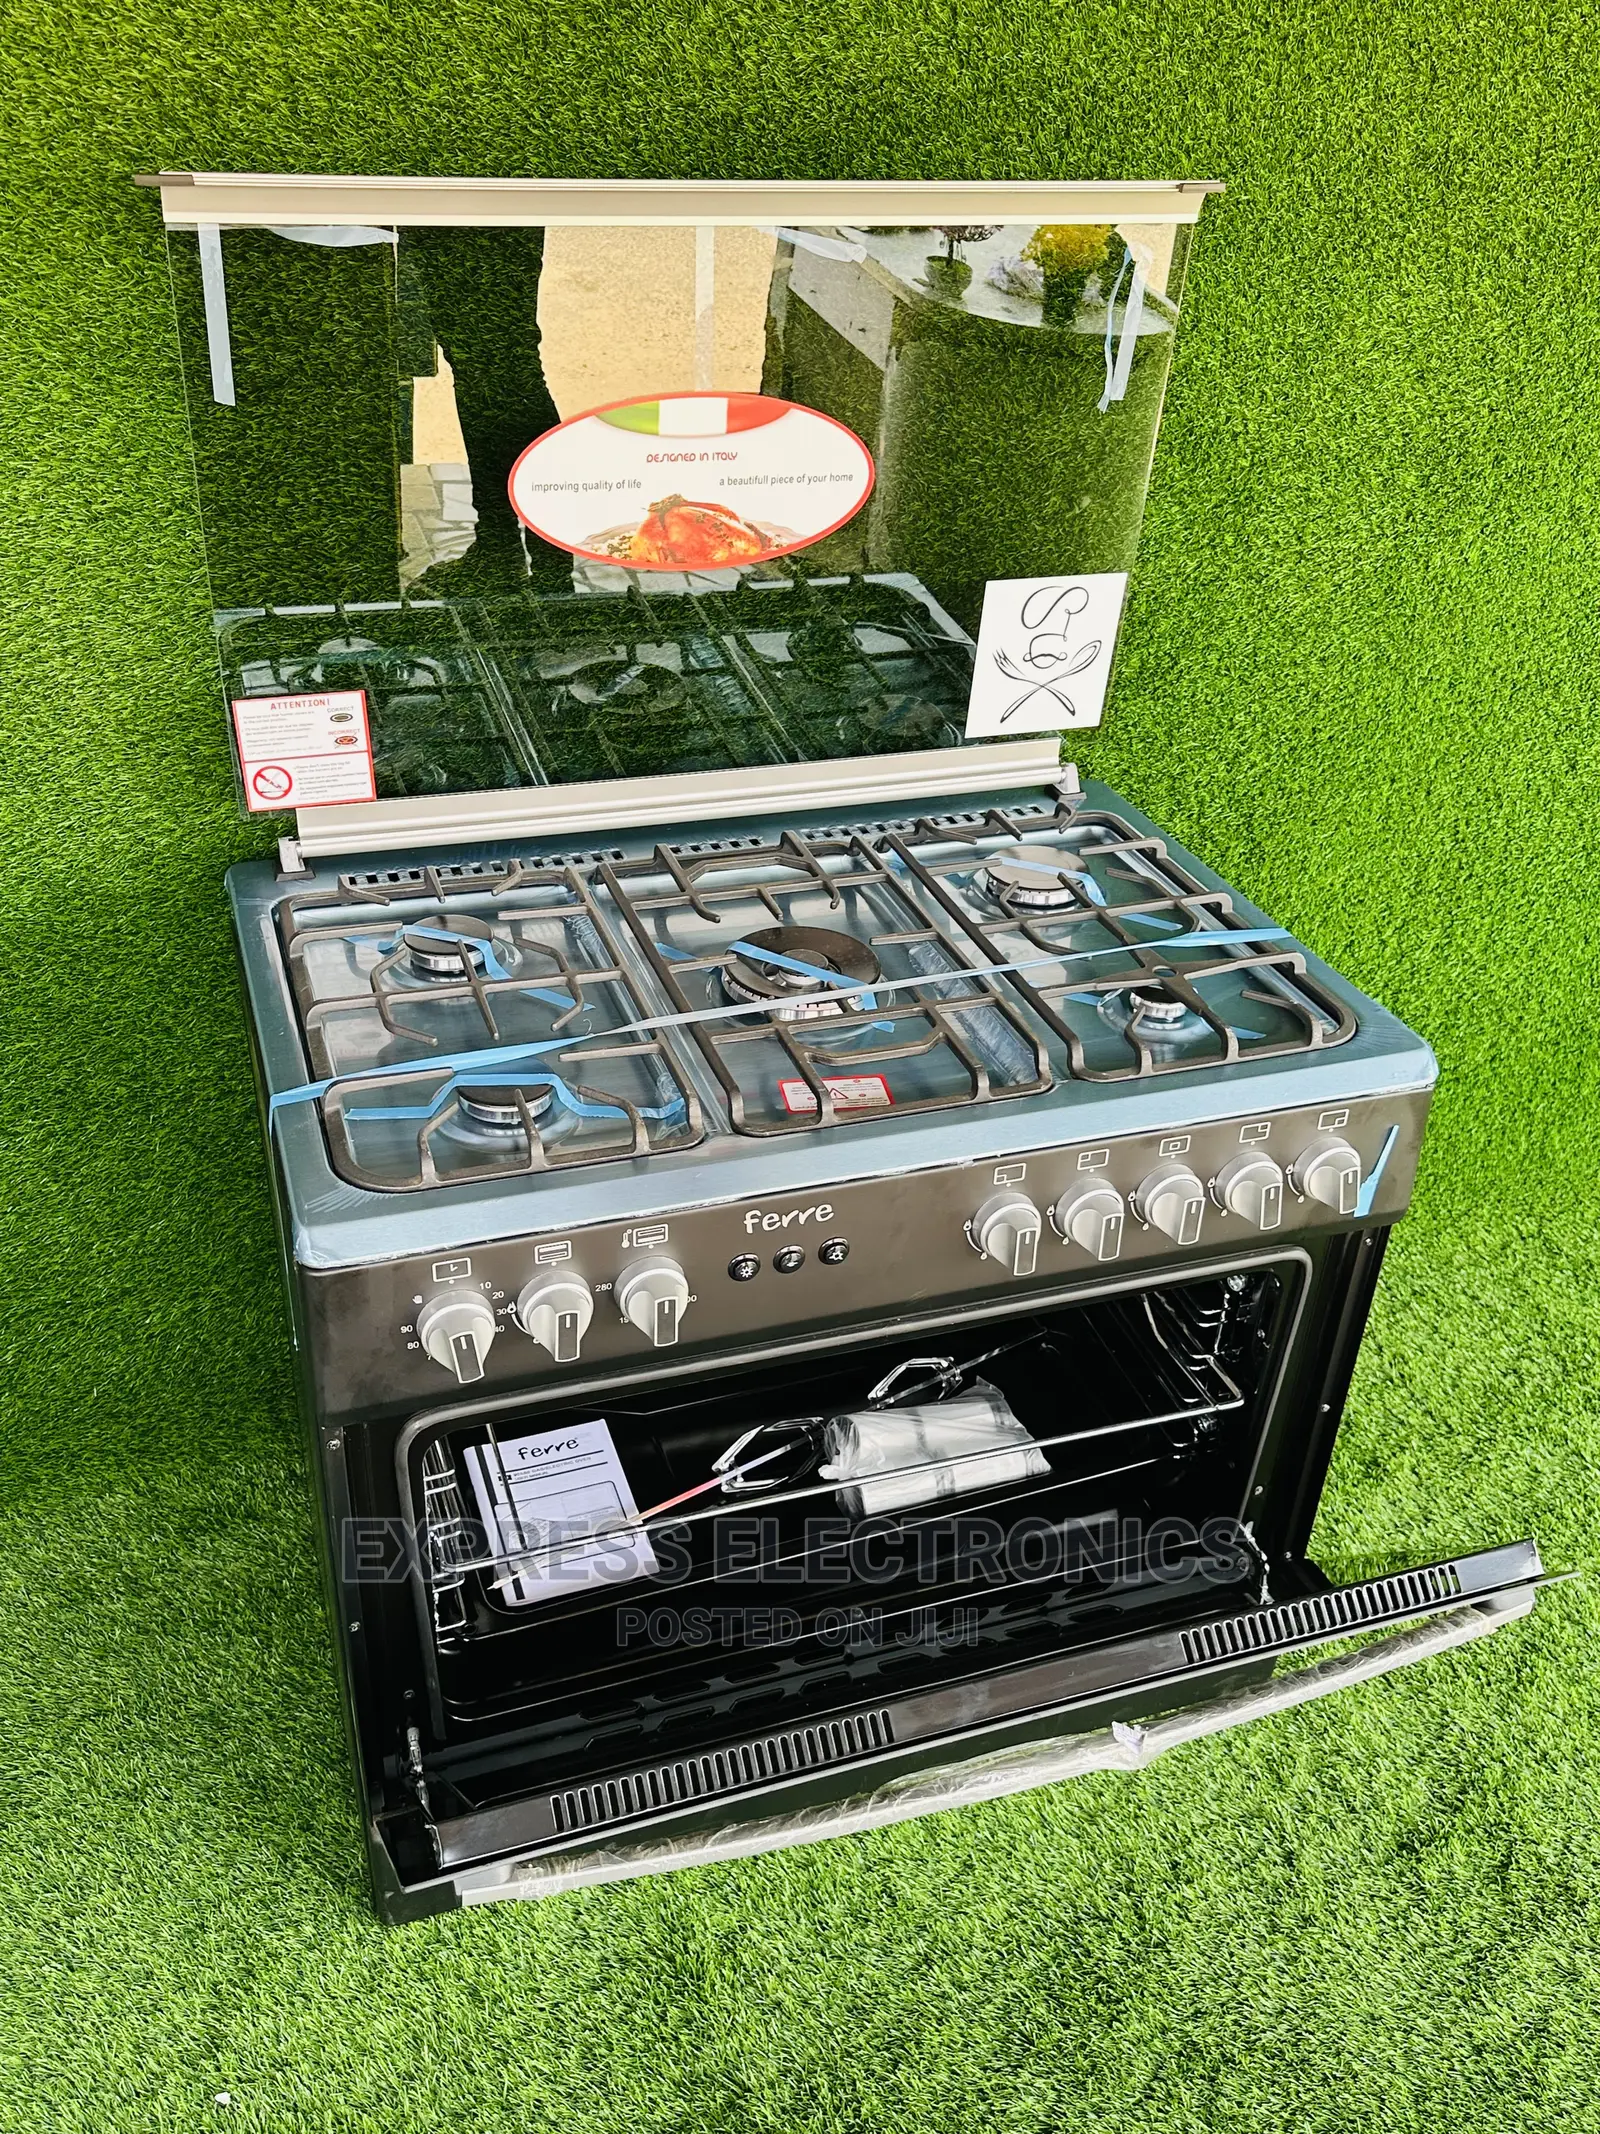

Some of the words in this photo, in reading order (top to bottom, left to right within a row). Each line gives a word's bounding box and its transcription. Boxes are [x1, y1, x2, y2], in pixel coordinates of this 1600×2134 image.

[646, 453, 697, 463] DESIGNED
[699, 452, 709, 461] IN
[712, 451, 738, 461] ITALY
[719, 477, 725, 486] a
[727, 475, 769, 486] beautifull
[770, 474, 795, 486] piece
[796, 473, 806, 484] of
[807, 474, 828, 485] your
[829, 473, 854, 482] home
[531, 481, 580, 493] improving
[582, 479, 613, 492] quality
[616, 479, 626, 490] of
[627, 479, 642, 489] life
[270, 698, 331, 710] ATTENTION!
[743, 1203, 835, 1234] ferre
[480, 1281, 492, 1290] 10
[595, 1282, 612, 1292] 280
[492, 1291, 504, 1299] 20
[496, 1308, 507, 1316] 30
[400, 1325, 413, 1333] 90
[407, 1341, 420, 1350] 80
[518, 1439, 579, 1460] ferre
